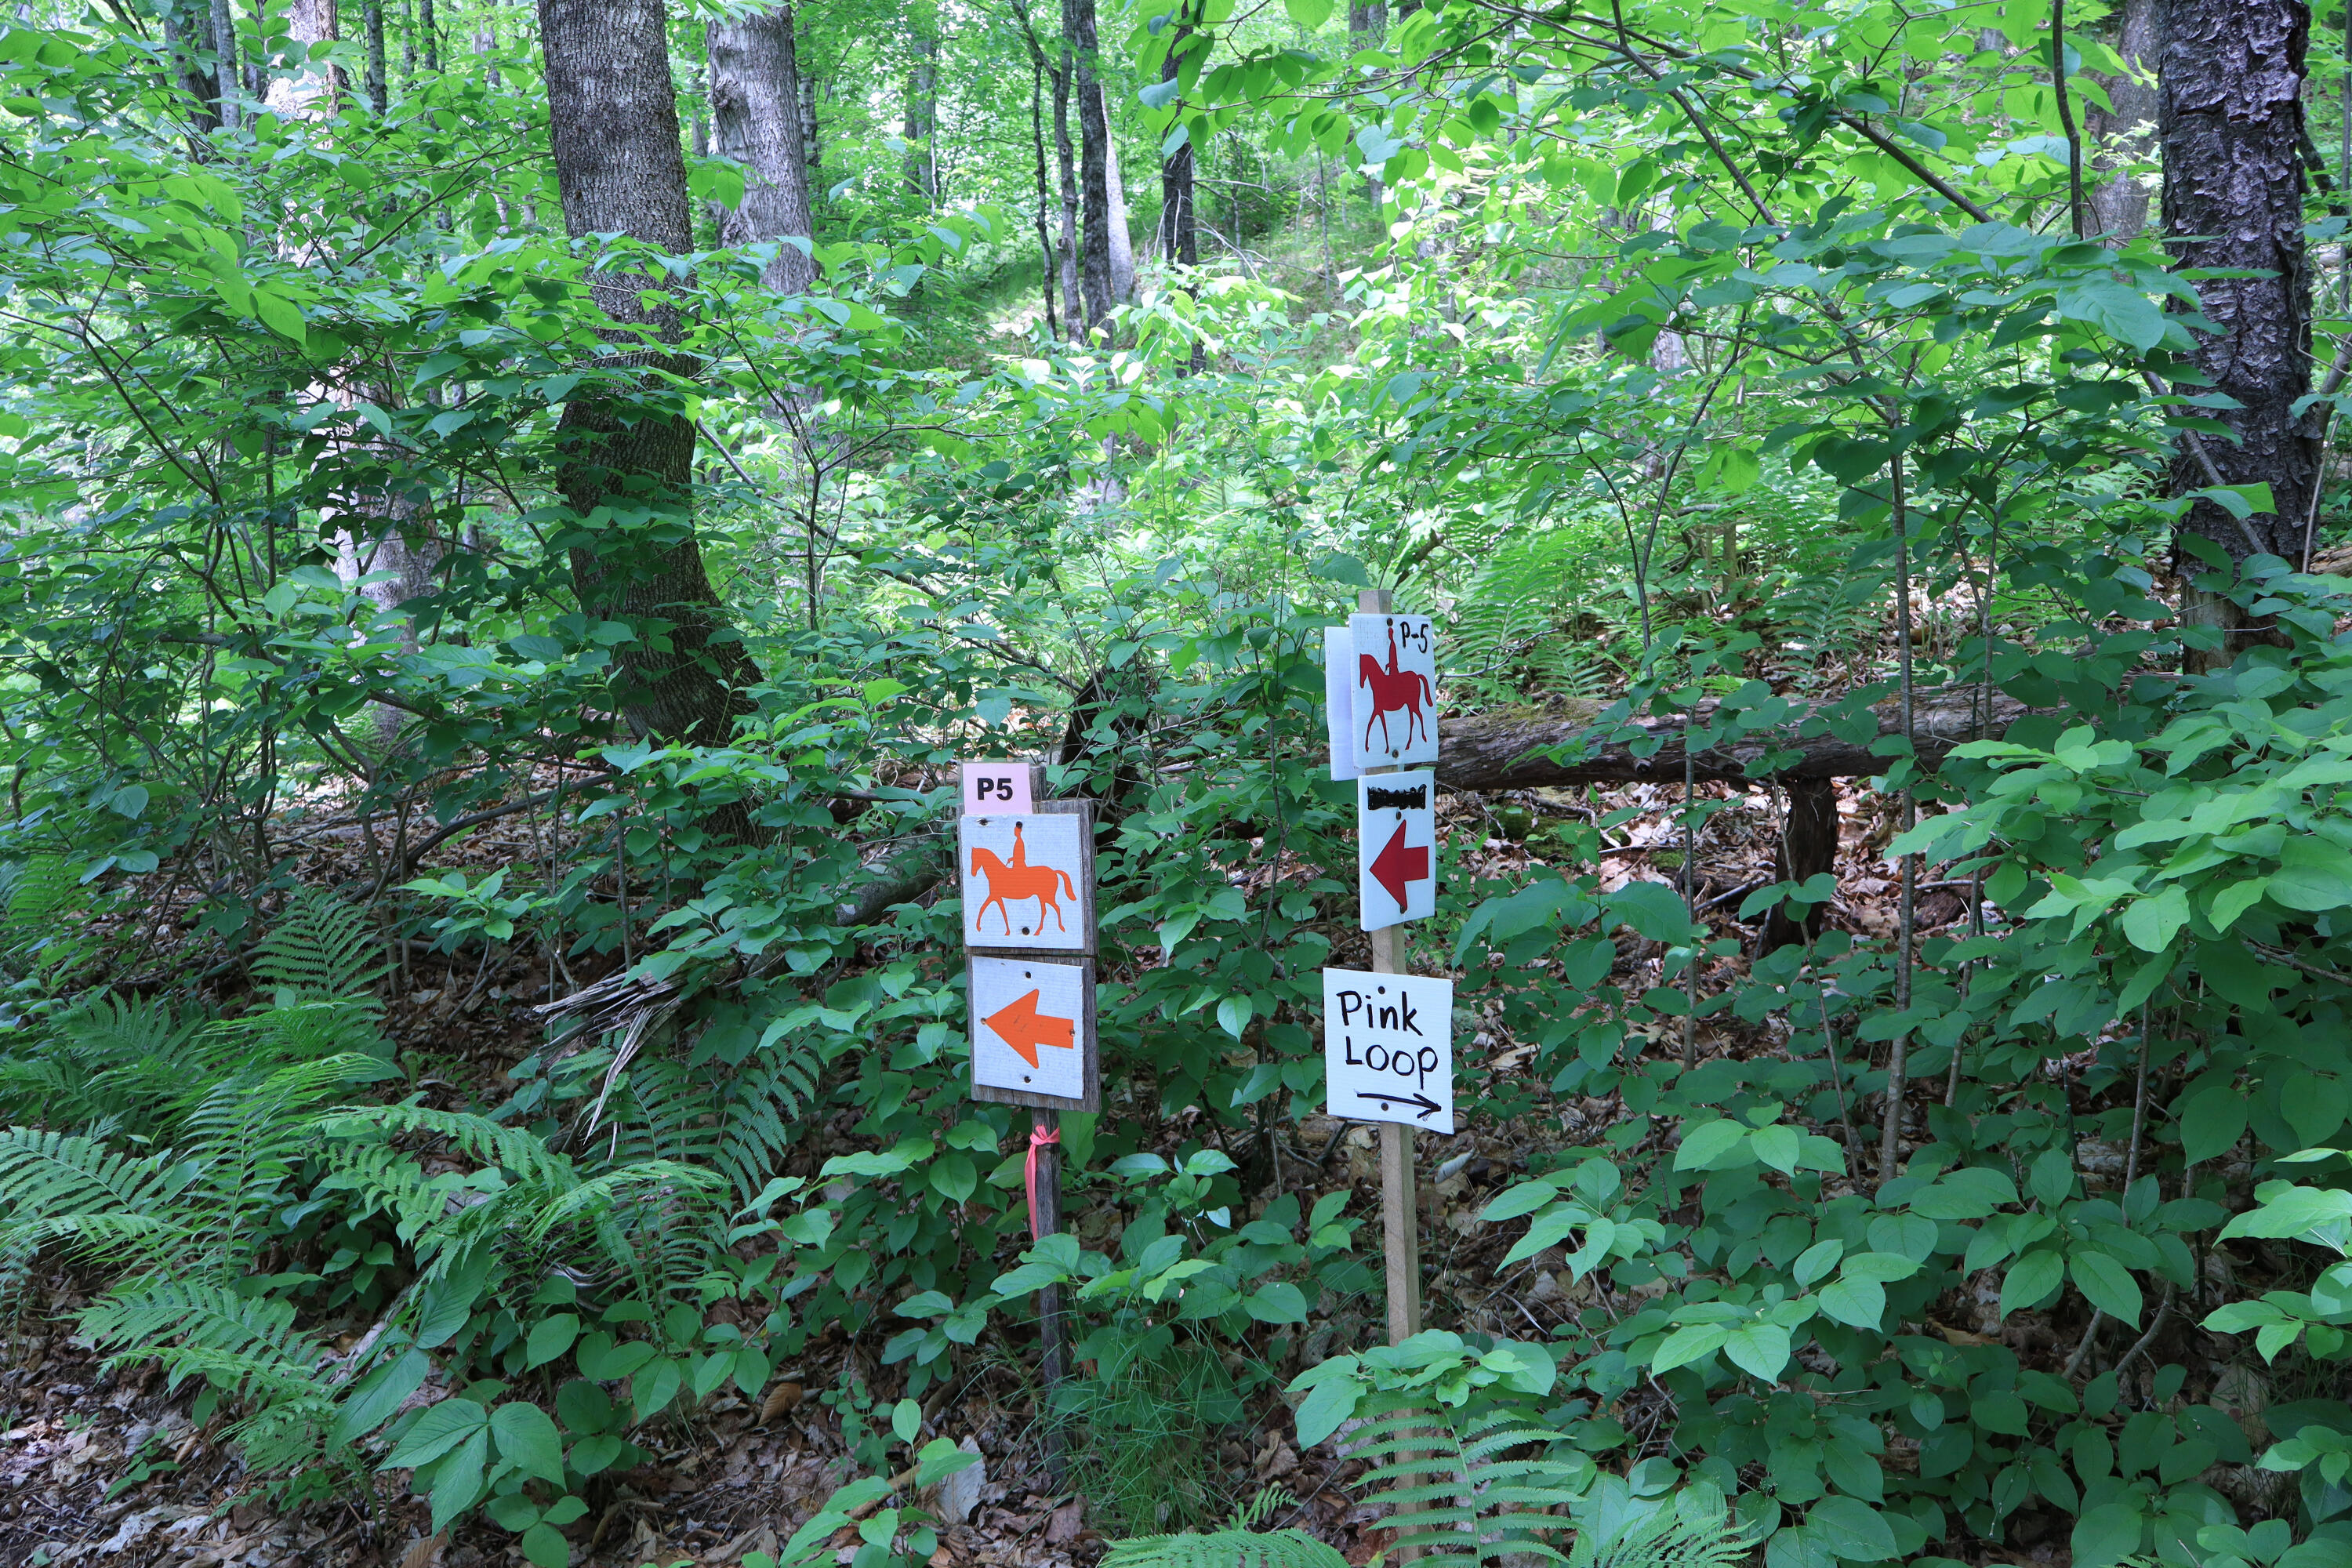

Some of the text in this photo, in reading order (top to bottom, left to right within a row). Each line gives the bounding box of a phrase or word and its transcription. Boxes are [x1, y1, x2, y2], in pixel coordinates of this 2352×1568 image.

[1399, 621, 1429, 654] P-5
[977, 778, 1014, 800] P5
[1336, 990, 1424, 1036] Pink
